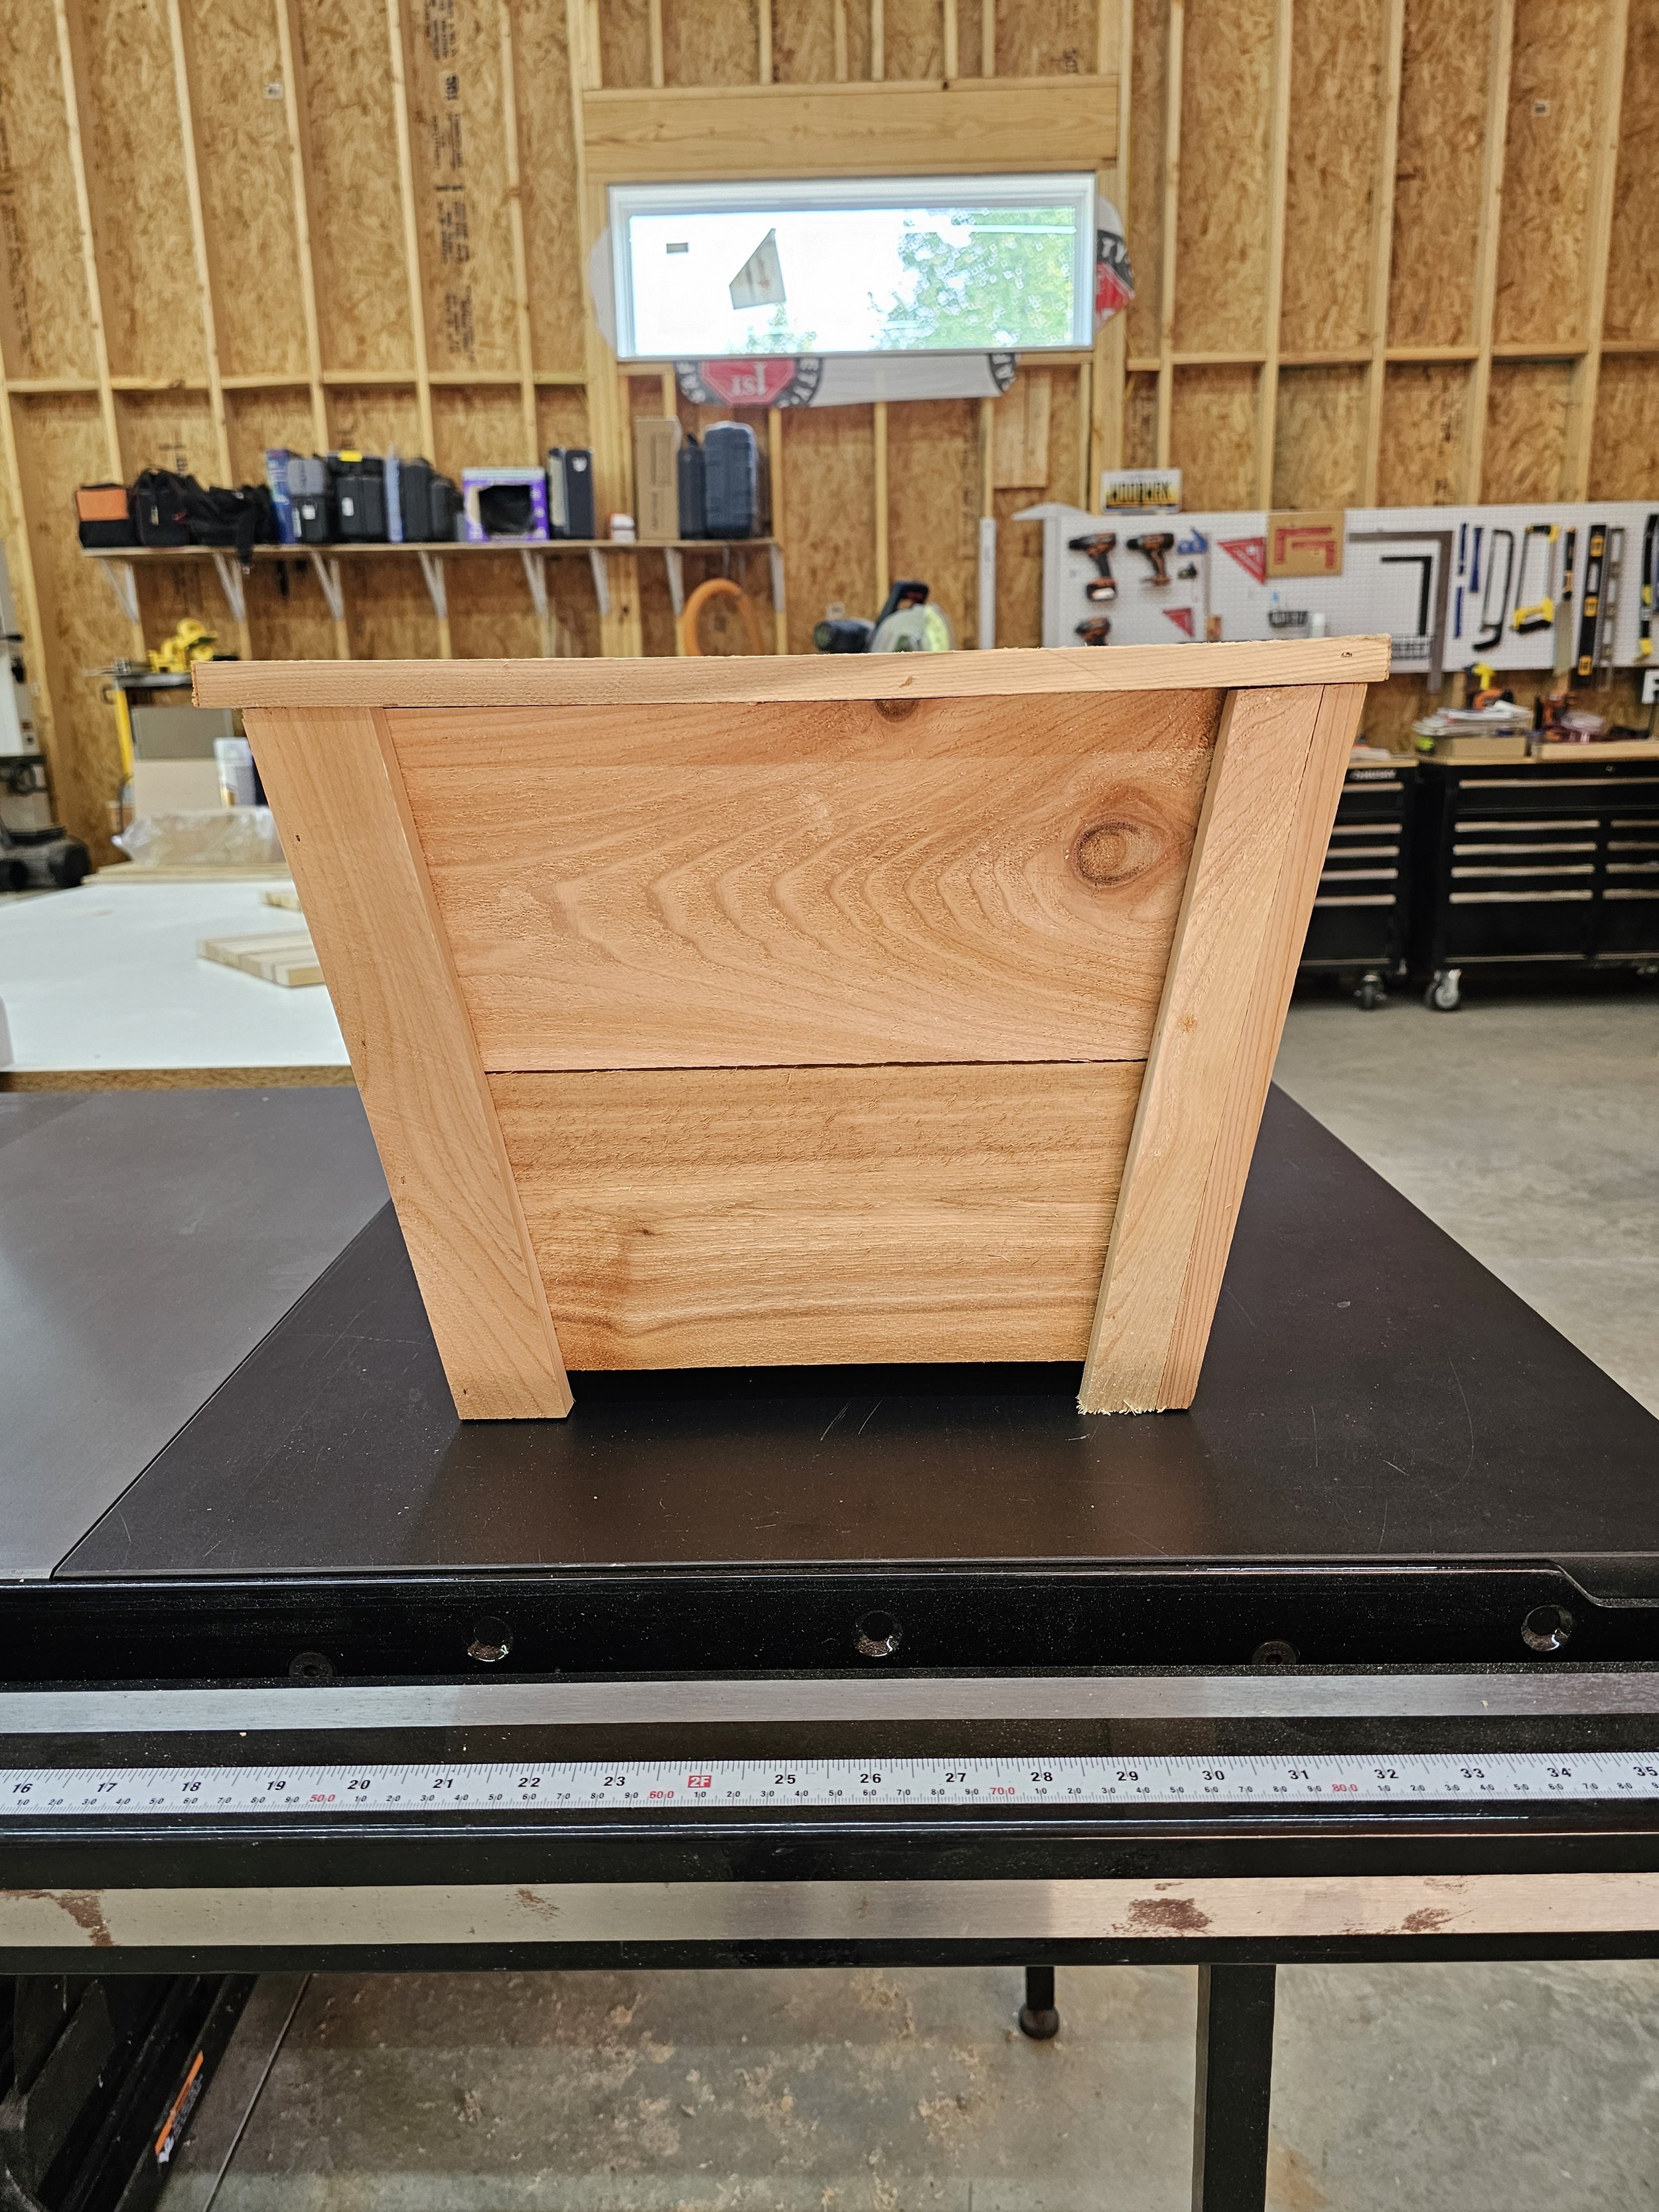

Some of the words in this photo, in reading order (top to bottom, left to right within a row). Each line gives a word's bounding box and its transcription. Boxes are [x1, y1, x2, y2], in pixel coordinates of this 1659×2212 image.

[13, 1784, 33, 1793] 16
[97, 1783, 117, 1792] 17
[182, 1782, 201, 1791] 18
[267, 1781, 286, 1790] 19
[347, 1780, 371, 1789] 20
[433, 1779, 454, 1788] 21
[518, 1778, 540, 1787] 22
[604, 1777, 625, 1786] 23
[689, 1776, 711, 1787] 2F
[775, 1775, 796, 1784] 25
[860, 1774, 881, 1783] 26
[945, 1773, 966, 1783] 27
[1030, 1772, 1053, 1781] 28
[1116, 1771, 1139, 1781] 29
[1202, 1771, 1225, 1780] 30
[1288, 1770, 1309, 1779] 31
[1374, 1769, 1399, 1779] 32
[1461, 1768, 1485, 1778] 33
[1547, 1767, 1571, 1777] 34
[1633, 1767, 1658, 1776] 35
